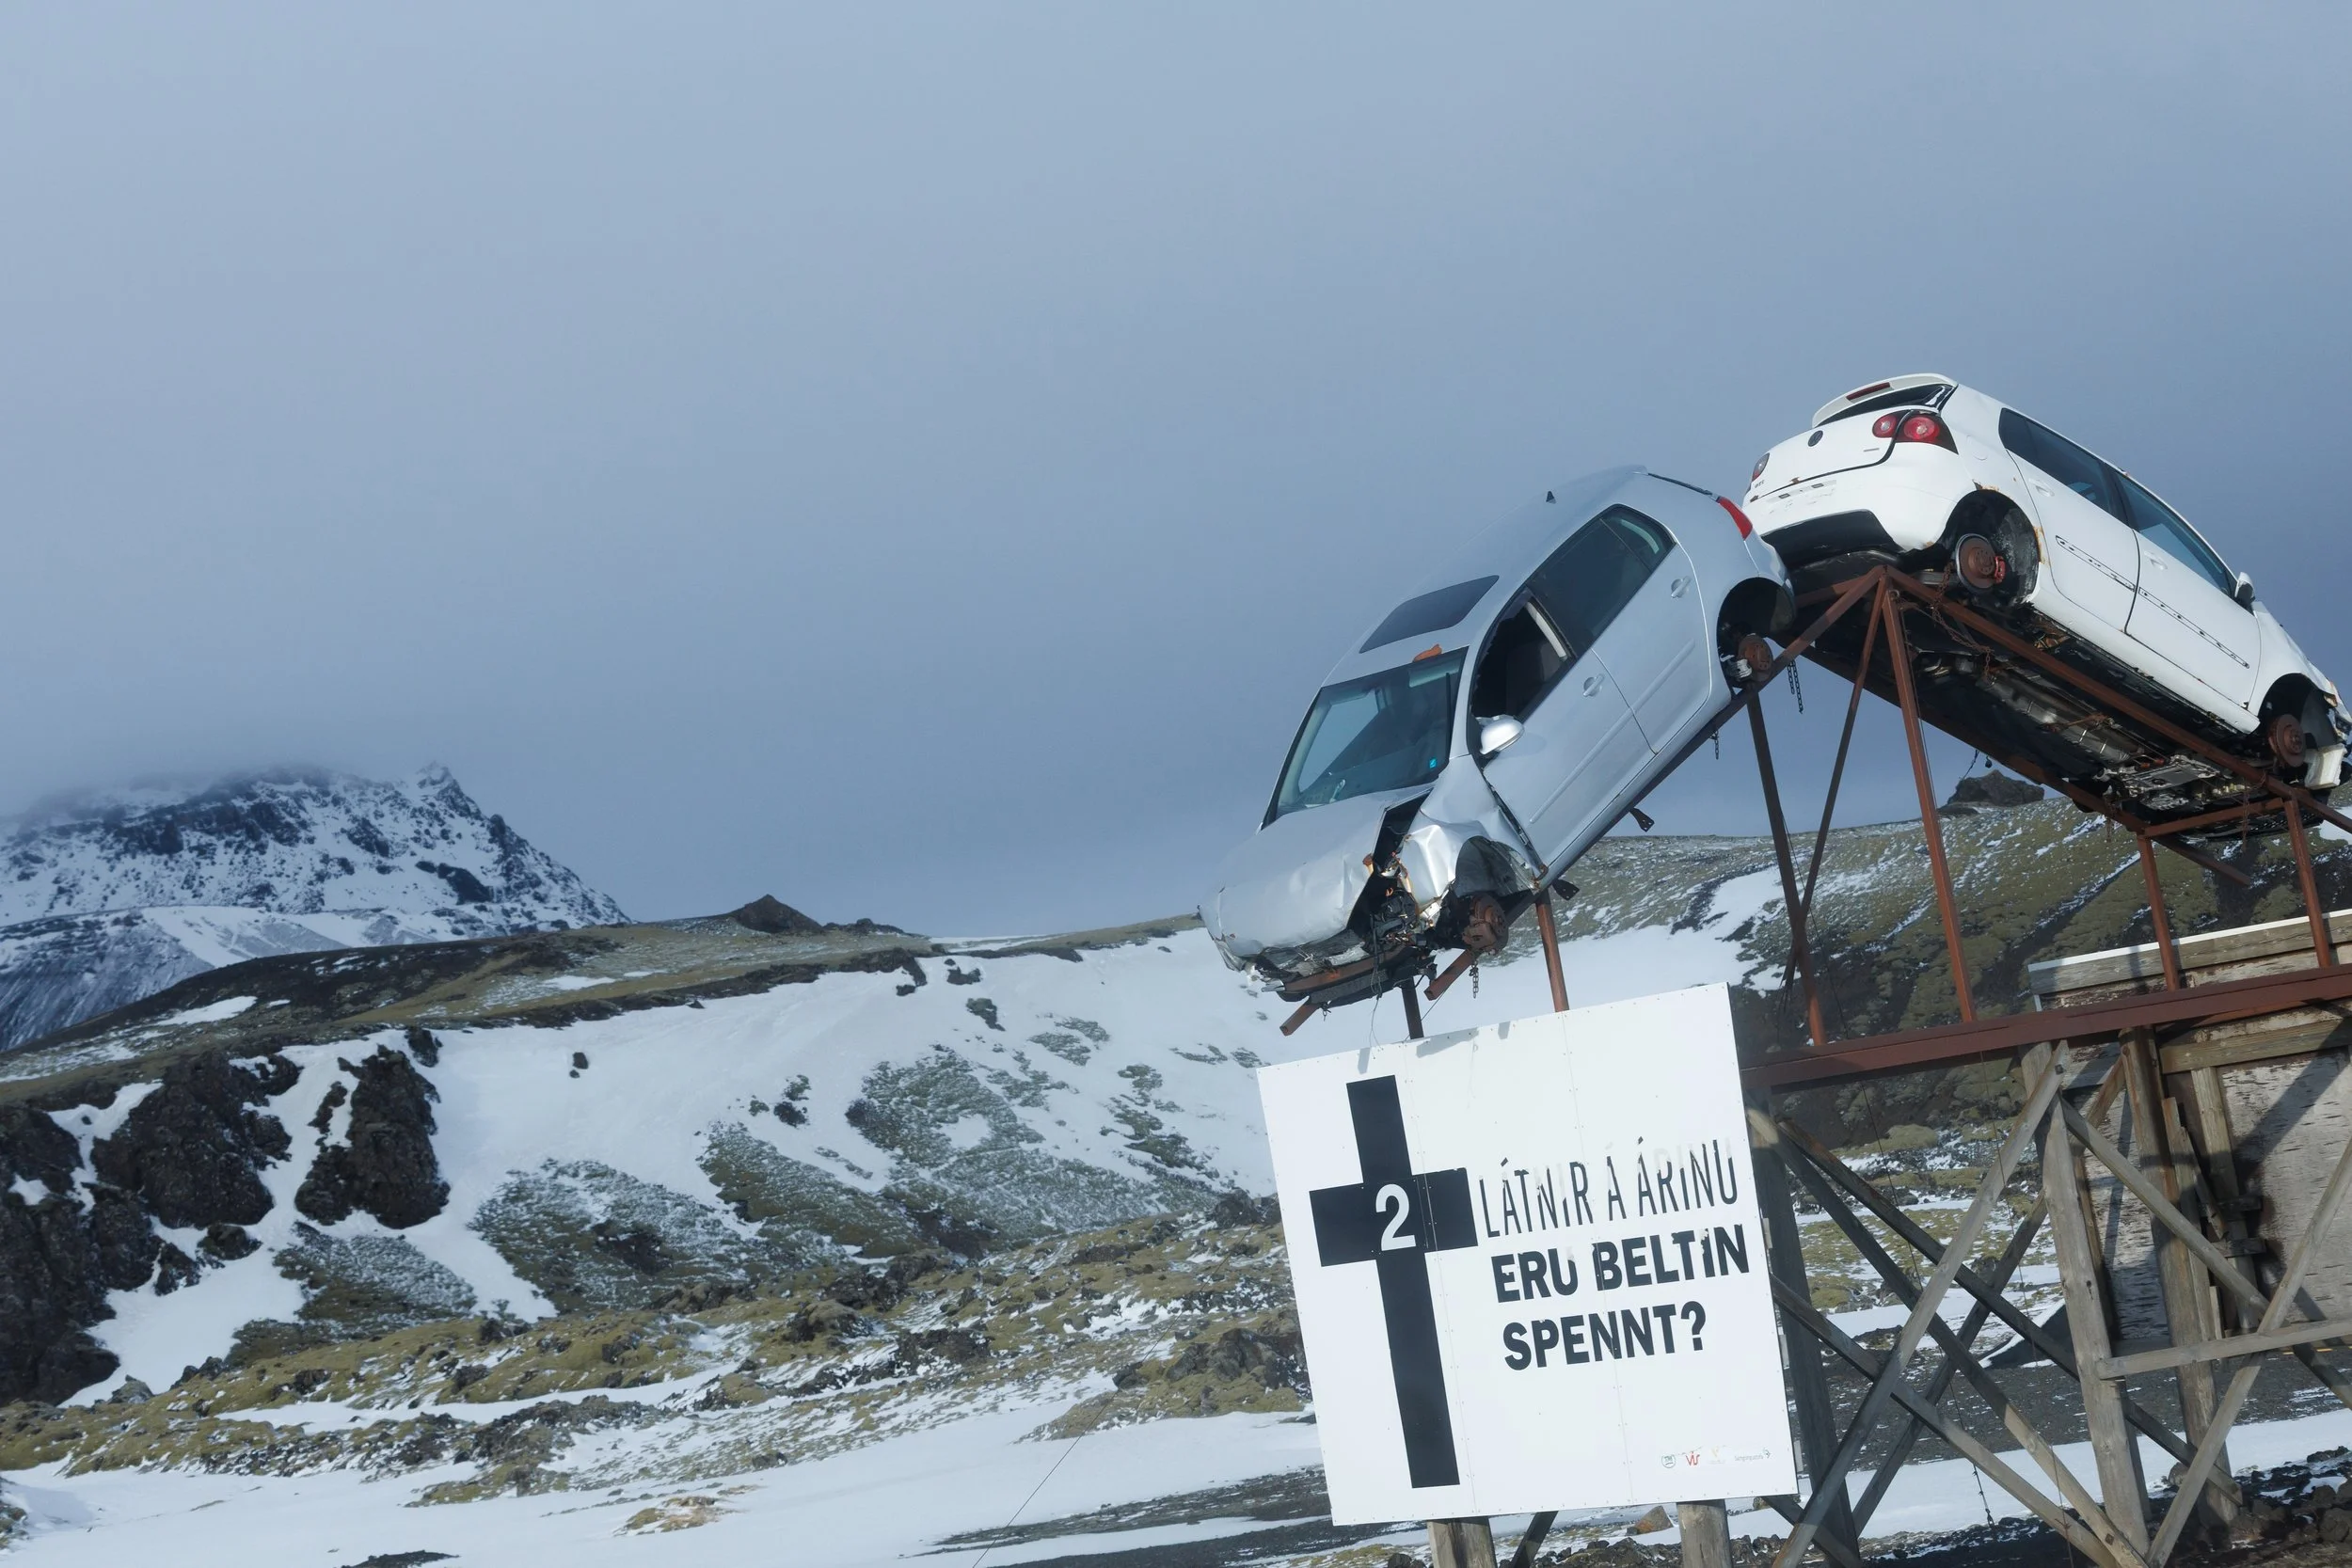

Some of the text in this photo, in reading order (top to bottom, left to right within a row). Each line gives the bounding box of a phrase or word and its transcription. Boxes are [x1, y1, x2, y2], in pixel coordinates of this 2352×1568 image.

[1375, 1183, 1417, 1252] 2
[1491, 1224, 1750, 1303] ERU BELTIN
[1502, 1301, 1707, 1370] SPENNT?
